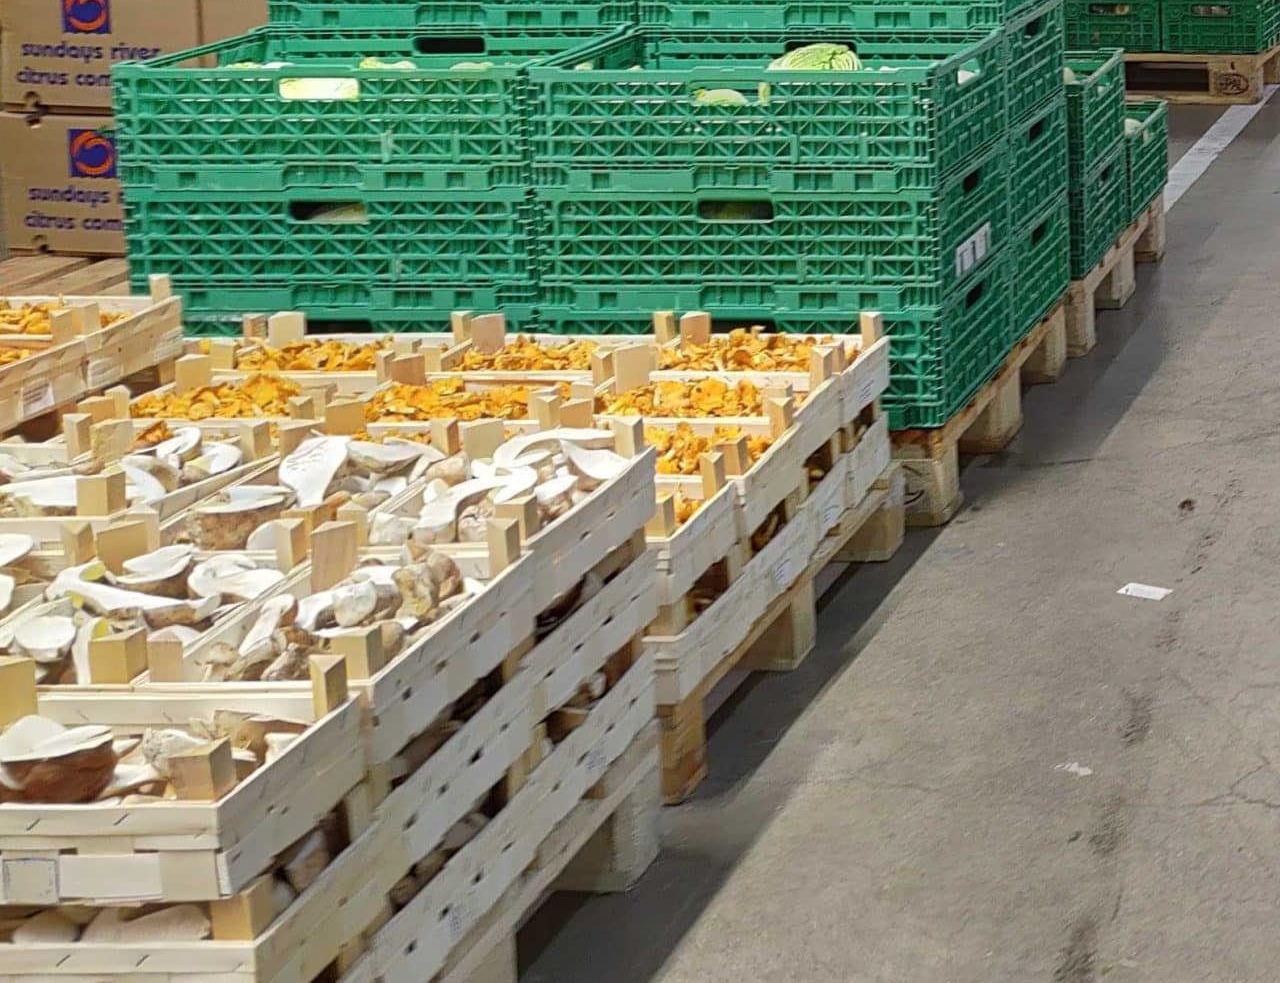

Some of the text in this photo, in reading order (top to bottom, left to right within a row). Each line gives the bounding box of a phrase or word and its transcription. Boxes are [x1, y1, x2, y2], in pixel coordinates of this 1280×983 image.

[21, 41, 161, 63] sundays river
[16, 66, 68, 86] citrus
[28, 185, 110, 208] sundays
[24, 210, 75, 229] citrus
